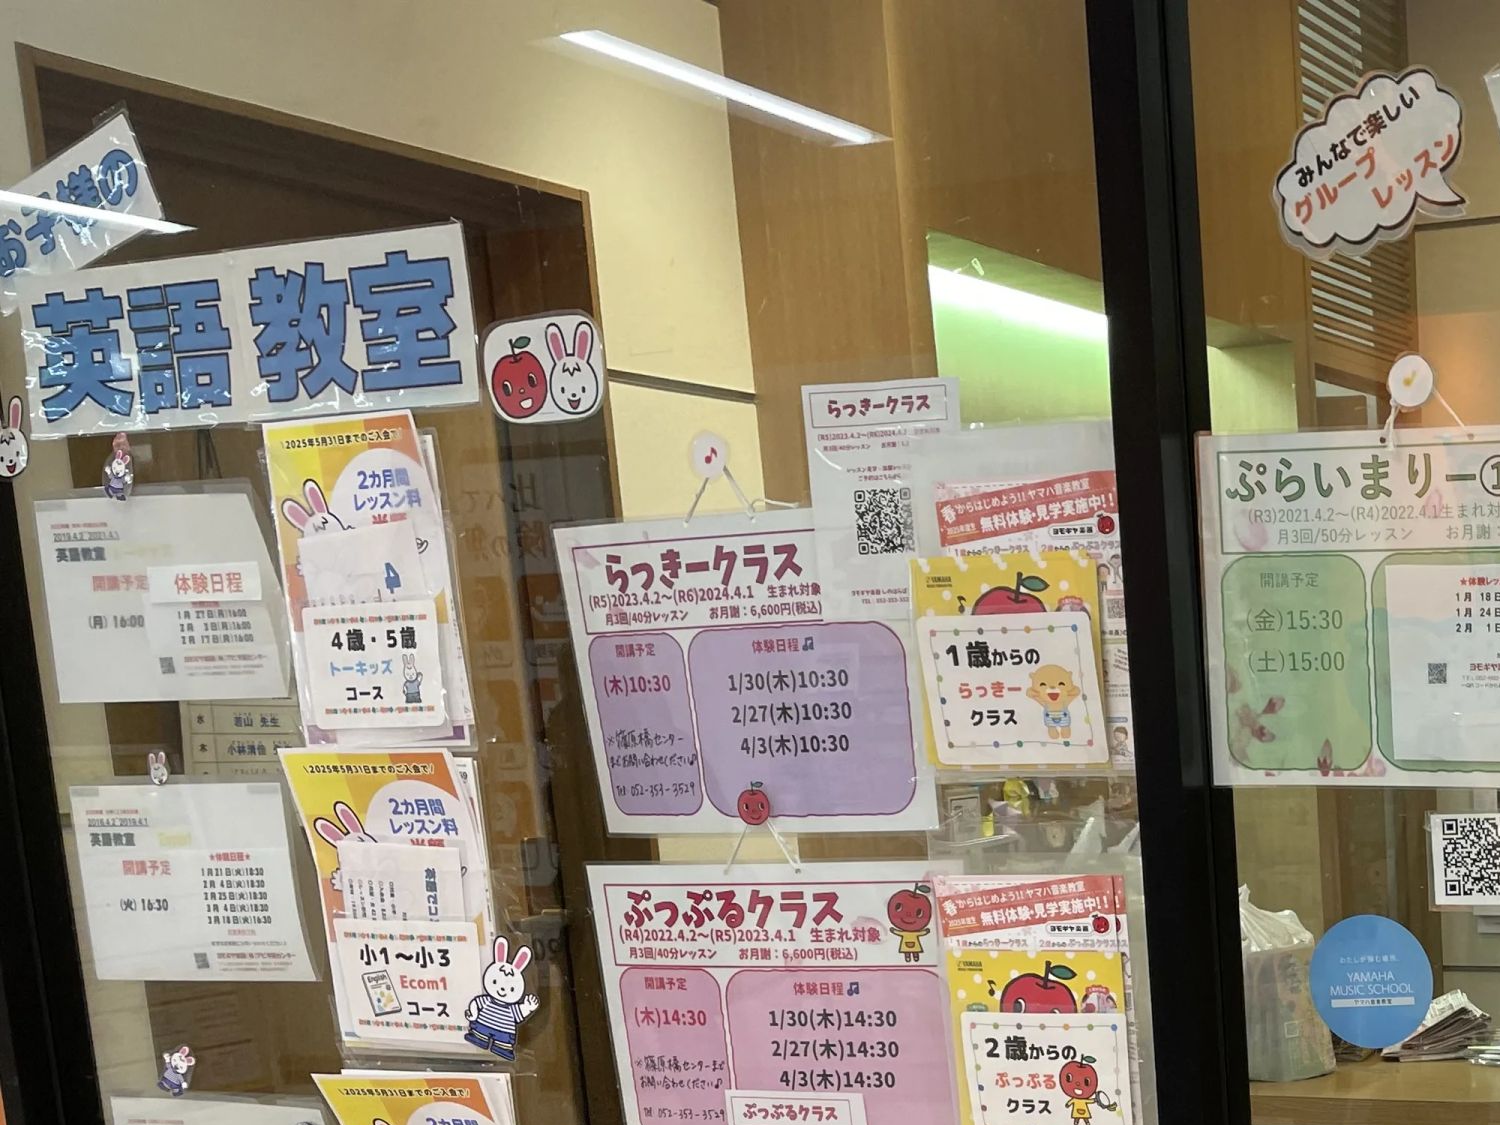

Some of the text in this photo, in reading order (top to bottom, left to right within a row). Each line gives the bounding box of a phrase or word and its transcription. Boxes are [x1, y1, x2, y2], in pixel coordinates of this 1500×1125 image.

[1295, 87, 1420, 187] みんなで楽しい
[1372, 134, 1453, 207] レッスン
[1296, 147, 1375, 224] グループ
[33, 250, 463, 421] 英語教室
[354, 493, 421, 510] レッスン料
[174, 573, 243, 594] 体験日程
[1260, 572, 1319, 588] 開講予定
[767, 584, 821, 597] 生まれ対象
[1246, 608, 1342, 632] (金)15:30
[615, 643, 655, 657] 開講予定
[752, 639, 800, 653] 体験日程
[946, 641, 1040, 668] 1歳からの
[330, 659, 393, 676] トーキッズ
[1248, 651, 1344, 673] (土)15:00
[603, 675, 671, 696] (木)10:30
[728, 669, 849, 693] 1/30(木)10:30
[959, 682, 1022, 698] らっきー
[346, 687, 383, 700] コース
[731, 702, 852, 725] 2/27(木)10:30
[970, 710, 1018, 726] クラス
[740, 734, 850, 758] 4/3(木)10:30
[389, 798, 446, 816] 2カ月間
[389, 818, 458, 837] レッスン料
[810, 928, 881, 942] 生まれ対象
[400, 975, 448, 990] Ecom1
[644, 977, 687, 990] 開講予定
[1346, 971, 1395, 982] YAMAHA
[793, 982, 844, 996] 体験日程
[1330, 982, 1414, 995] MUSIC SCHOOL
[407, 1001, 449, 1018] コース
[635, 1008, 707, 1027] (木)14:30
[769, 1009, 897, 1030] 1/30(木)14:30
[771, 1040, 899, 1059] 2/27(木)14:30
[984, 1036, 1076, 1061] 2歳からの
[779, 1070, 896, 1090] 4/3(木)14:30
[995, 1072, 1056, 1090] ぷっぷる
[1007, 1098, 1052, 1114] クラス
